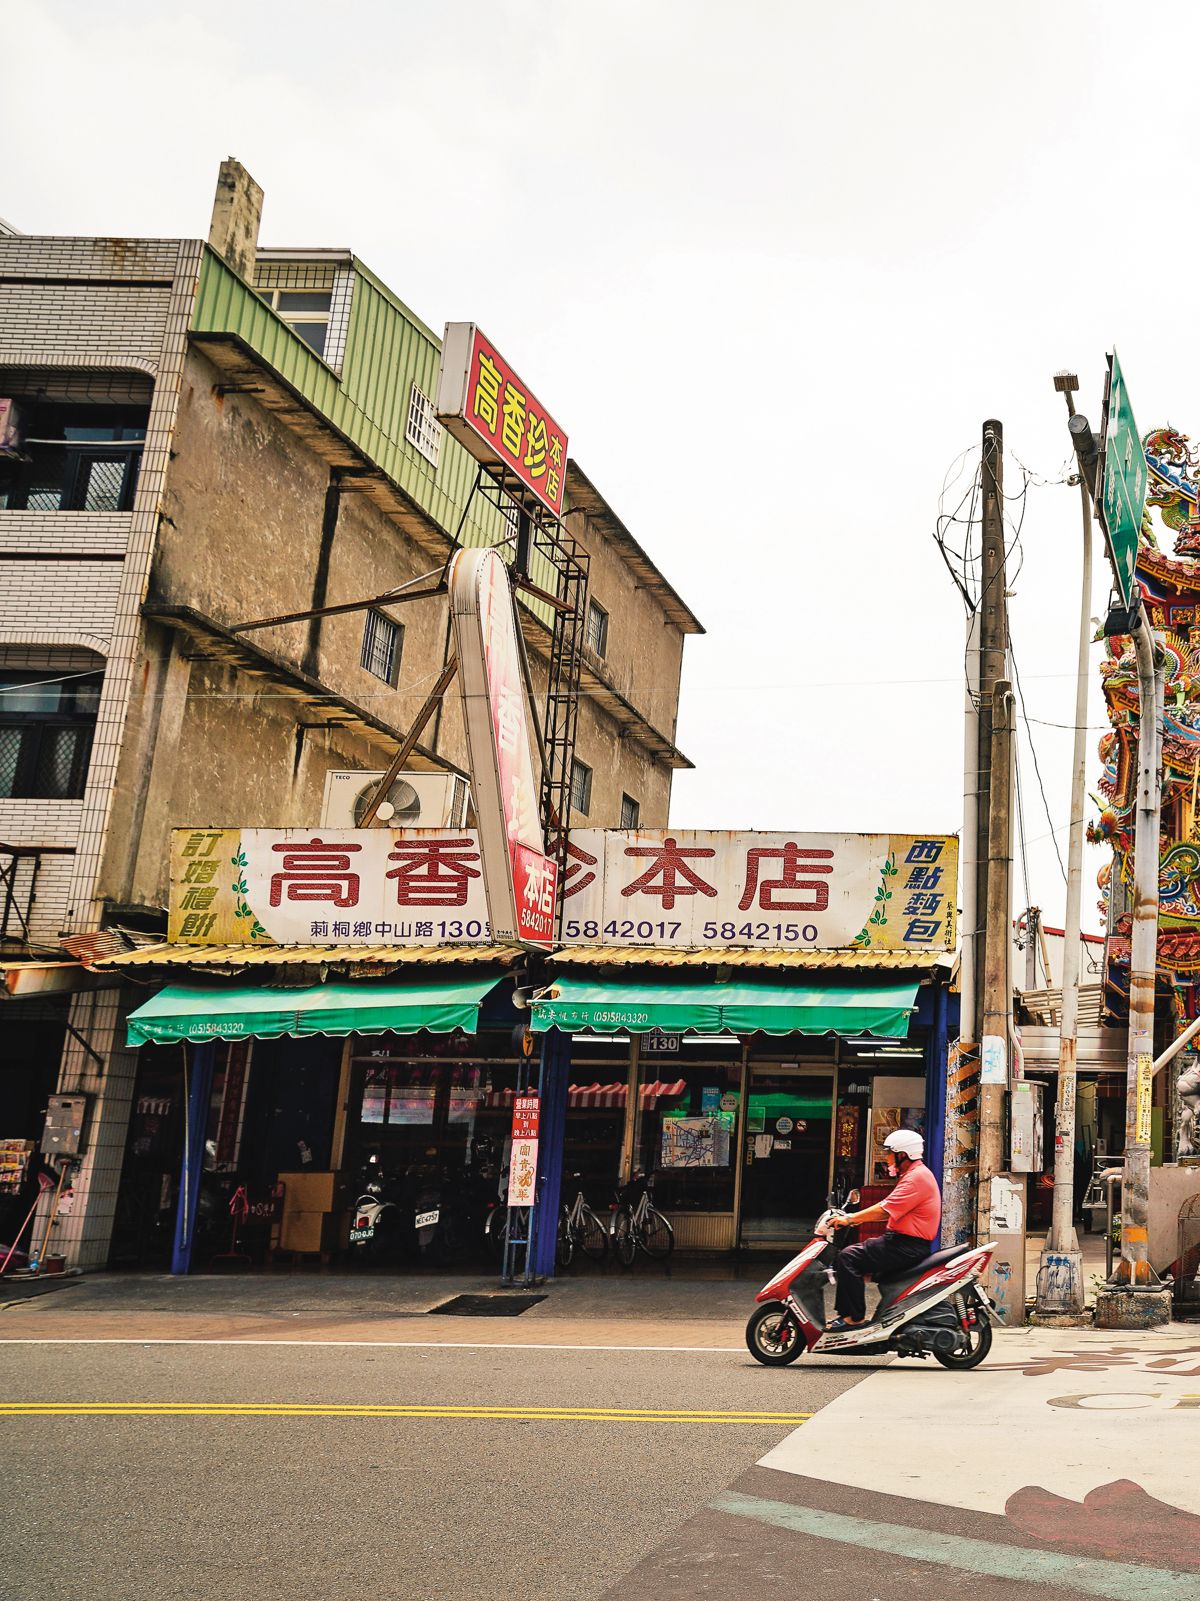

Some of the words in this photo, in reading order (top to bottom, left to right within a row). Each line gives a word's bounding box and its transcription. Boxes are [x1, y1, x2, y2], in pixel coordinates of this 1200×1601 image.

[473, 352, 549, 478] 高香珍
[545, 434, 564, 502] 本店
[178, 832, 224, 938] 訂婚禮餅
[523, 860, 554, 915] 本店
[902, 839, 946, 942] 西點麵包
[520, 907, 553, 936] 5842017
[565, 920, 682, 940] 5842017
[702, 921, 818, 942] 5842150
[188, 1023, 244, 1035] (05)5843320
[594, 1011, 649, 1024] (05)5843320
[651, 1037, 677, 1050] 130
[515, 1098, 539, 1111] 營業時間
[515, 1112, 538, 1121] 早上八點
